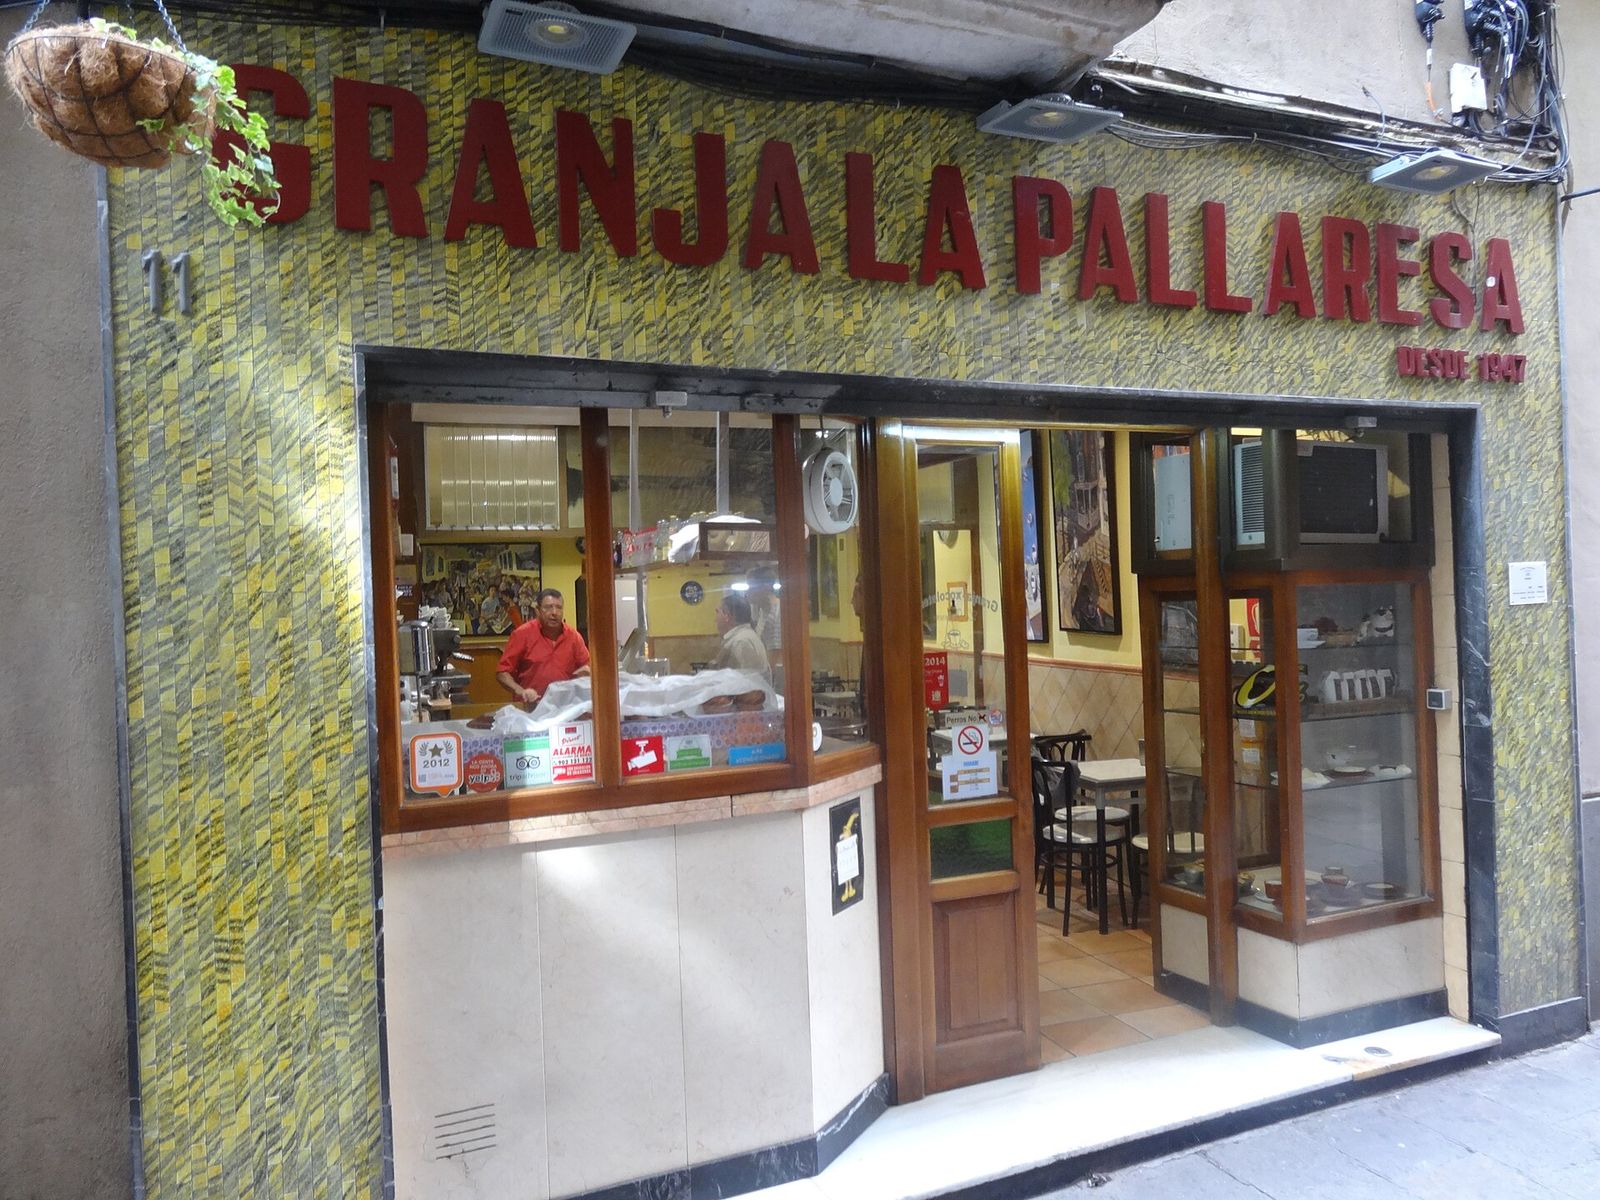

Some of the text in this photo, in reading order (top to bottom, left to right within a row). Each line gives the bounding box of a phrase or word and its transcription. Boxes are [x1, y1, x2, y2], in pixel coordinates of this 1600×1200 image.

[212, 63, 1526, 335] GRANJA LA PALLARESA
[143, 249, 191, 315] 11
[1397, 345, 1527, 384] DESDE 1947
[925, 656, 945, 666] 2014
[946, 715, 967, 724] Perros
[553, 744, 592, 756] ALARMA
[423, 758, 450, 769] 2012
[468, 773, 490, 784] yelp
